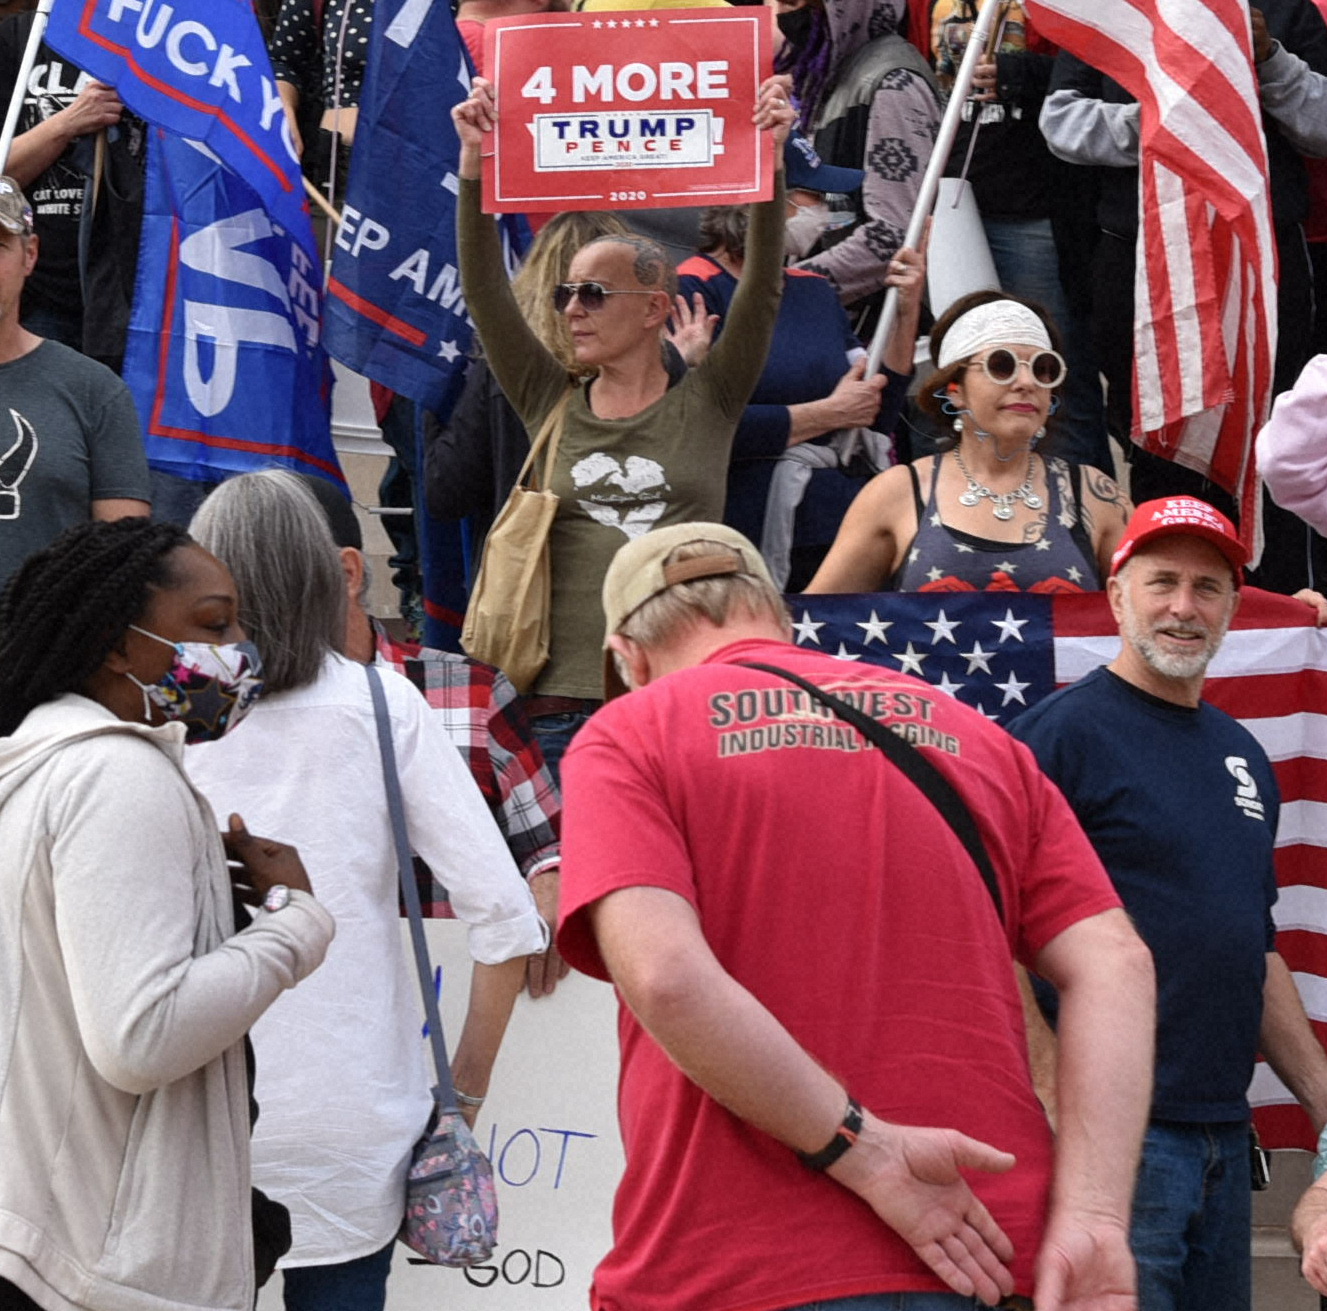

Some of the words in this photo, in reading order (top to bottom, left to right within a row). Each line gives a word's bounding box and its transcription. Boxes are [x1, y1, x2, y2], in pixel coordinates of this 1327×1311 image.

[521, 66, 557, 104] 4
[572, 60, 730, 104] MORE
[552, 117, 696, 140] TRUMP
[565, 139, 683, 154] PENCE
[609, 191, 647, 201] 2020
[37, 203, 72, 215] WHITE
[1166, 499, 1214, 513] KEEP
[718, 724, 860, 758] INDUSTRIAL
[489, 1123, 598, 1189] OT
